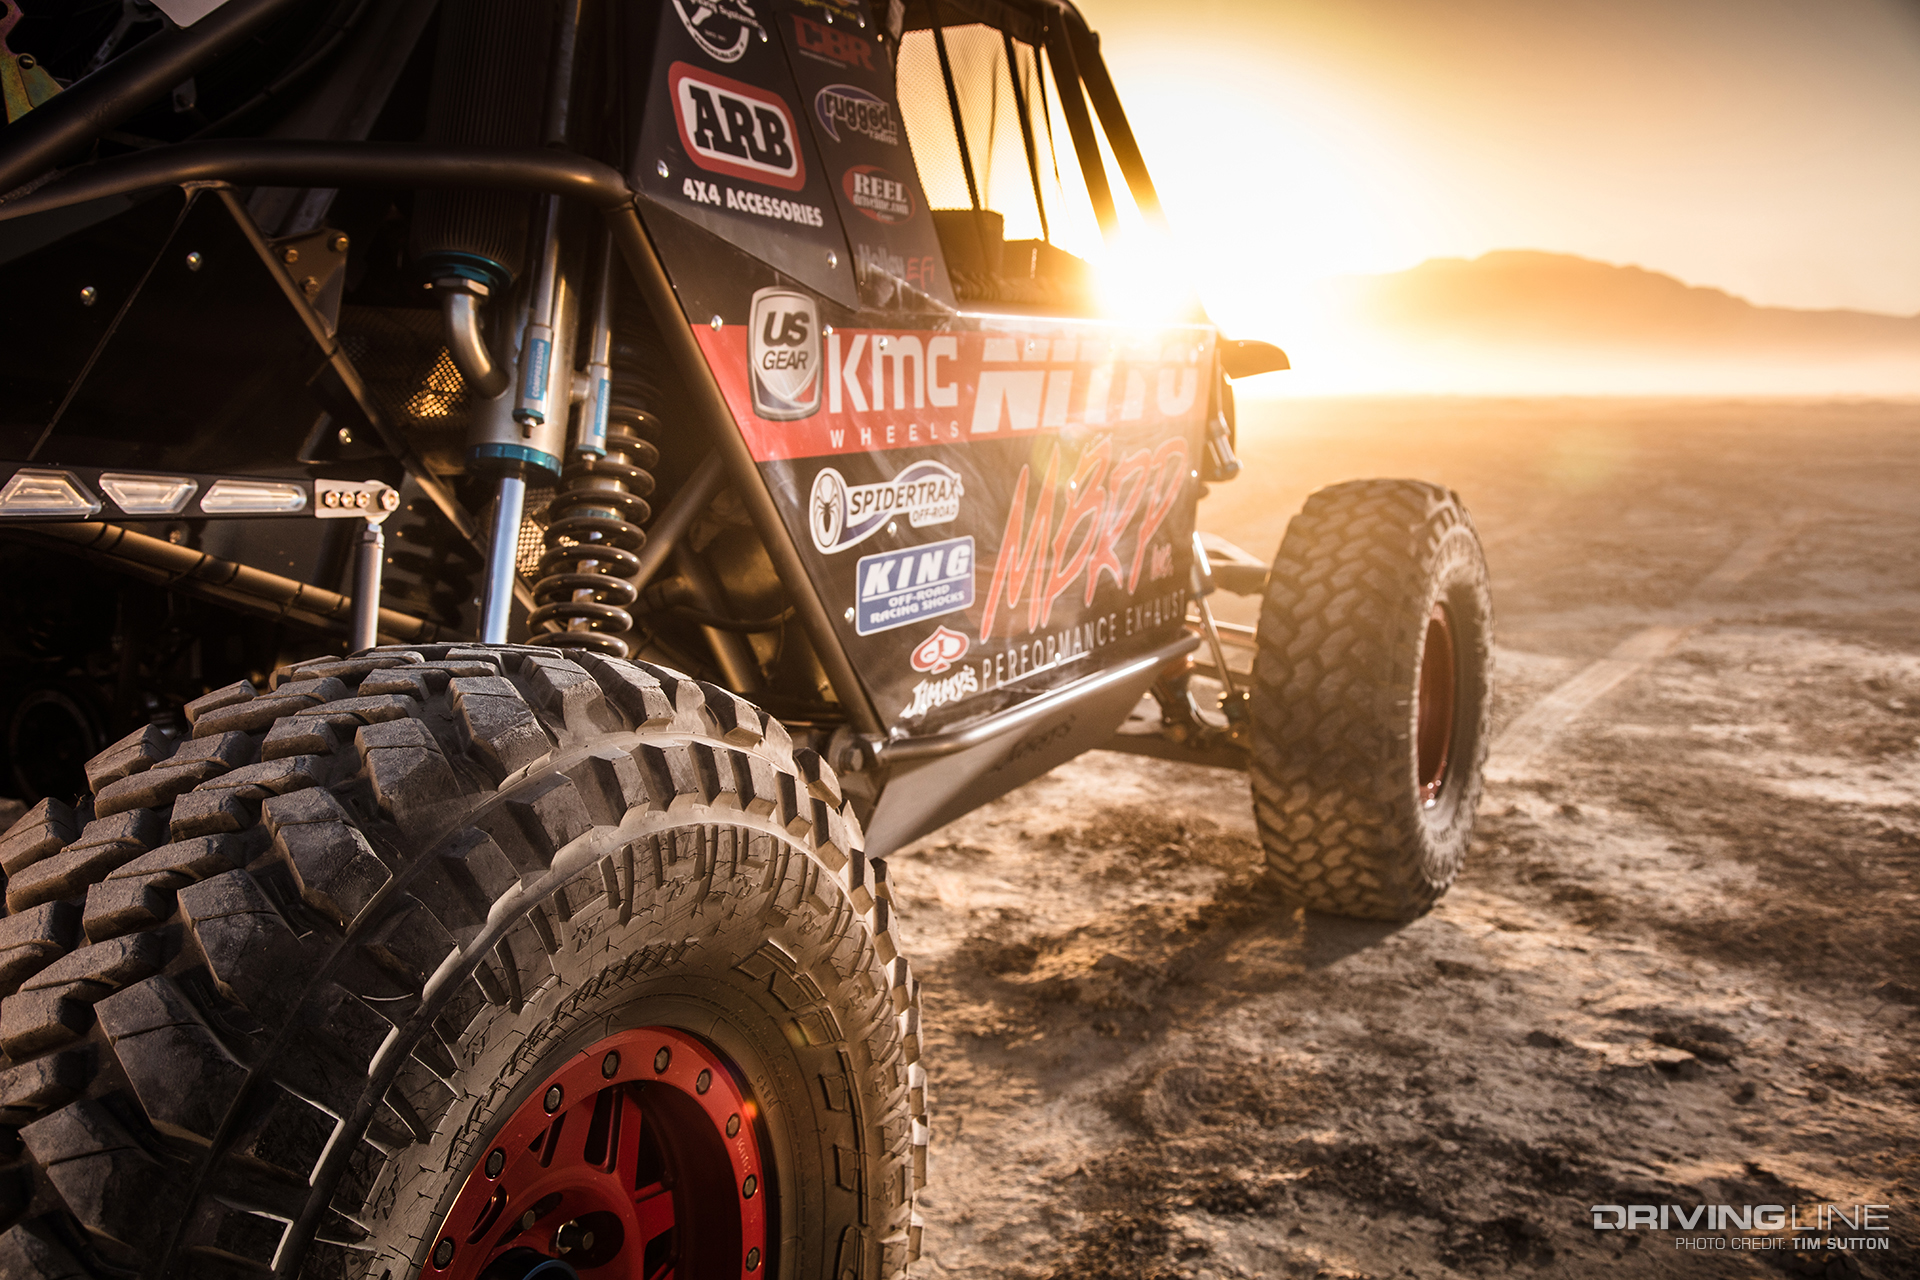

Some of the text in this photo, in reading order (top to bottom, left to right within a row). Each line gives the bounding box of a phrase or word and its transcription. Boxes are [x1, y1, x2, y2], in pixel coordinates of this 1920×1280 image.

[790, 13, 876, 71] CBR
[688, 84, 794, 170] ARB
[822, 90, 892, 134] rugged
[682, 177, 824, 228] 4X4 ACCESSORIES
[853, 171, 907, 203] REEL
[763, 311, 810, 347] US
[763, 350, 809, 371] GEAR
[827, 333, 959, 414] KMC
[829, 421, 959, 449] WHEELS
[850, 477, 962, 516] SPIDERTRAX
[911, 504, 957, 523] OFF-ROAD
[862, 544, 971, 597] KING
[869, 590, 965, 624] RACING SHOCKS
[888, 584, 950, 608] OFF-ROAD
[982, 612, 1117, 692] PERFORMANCE
